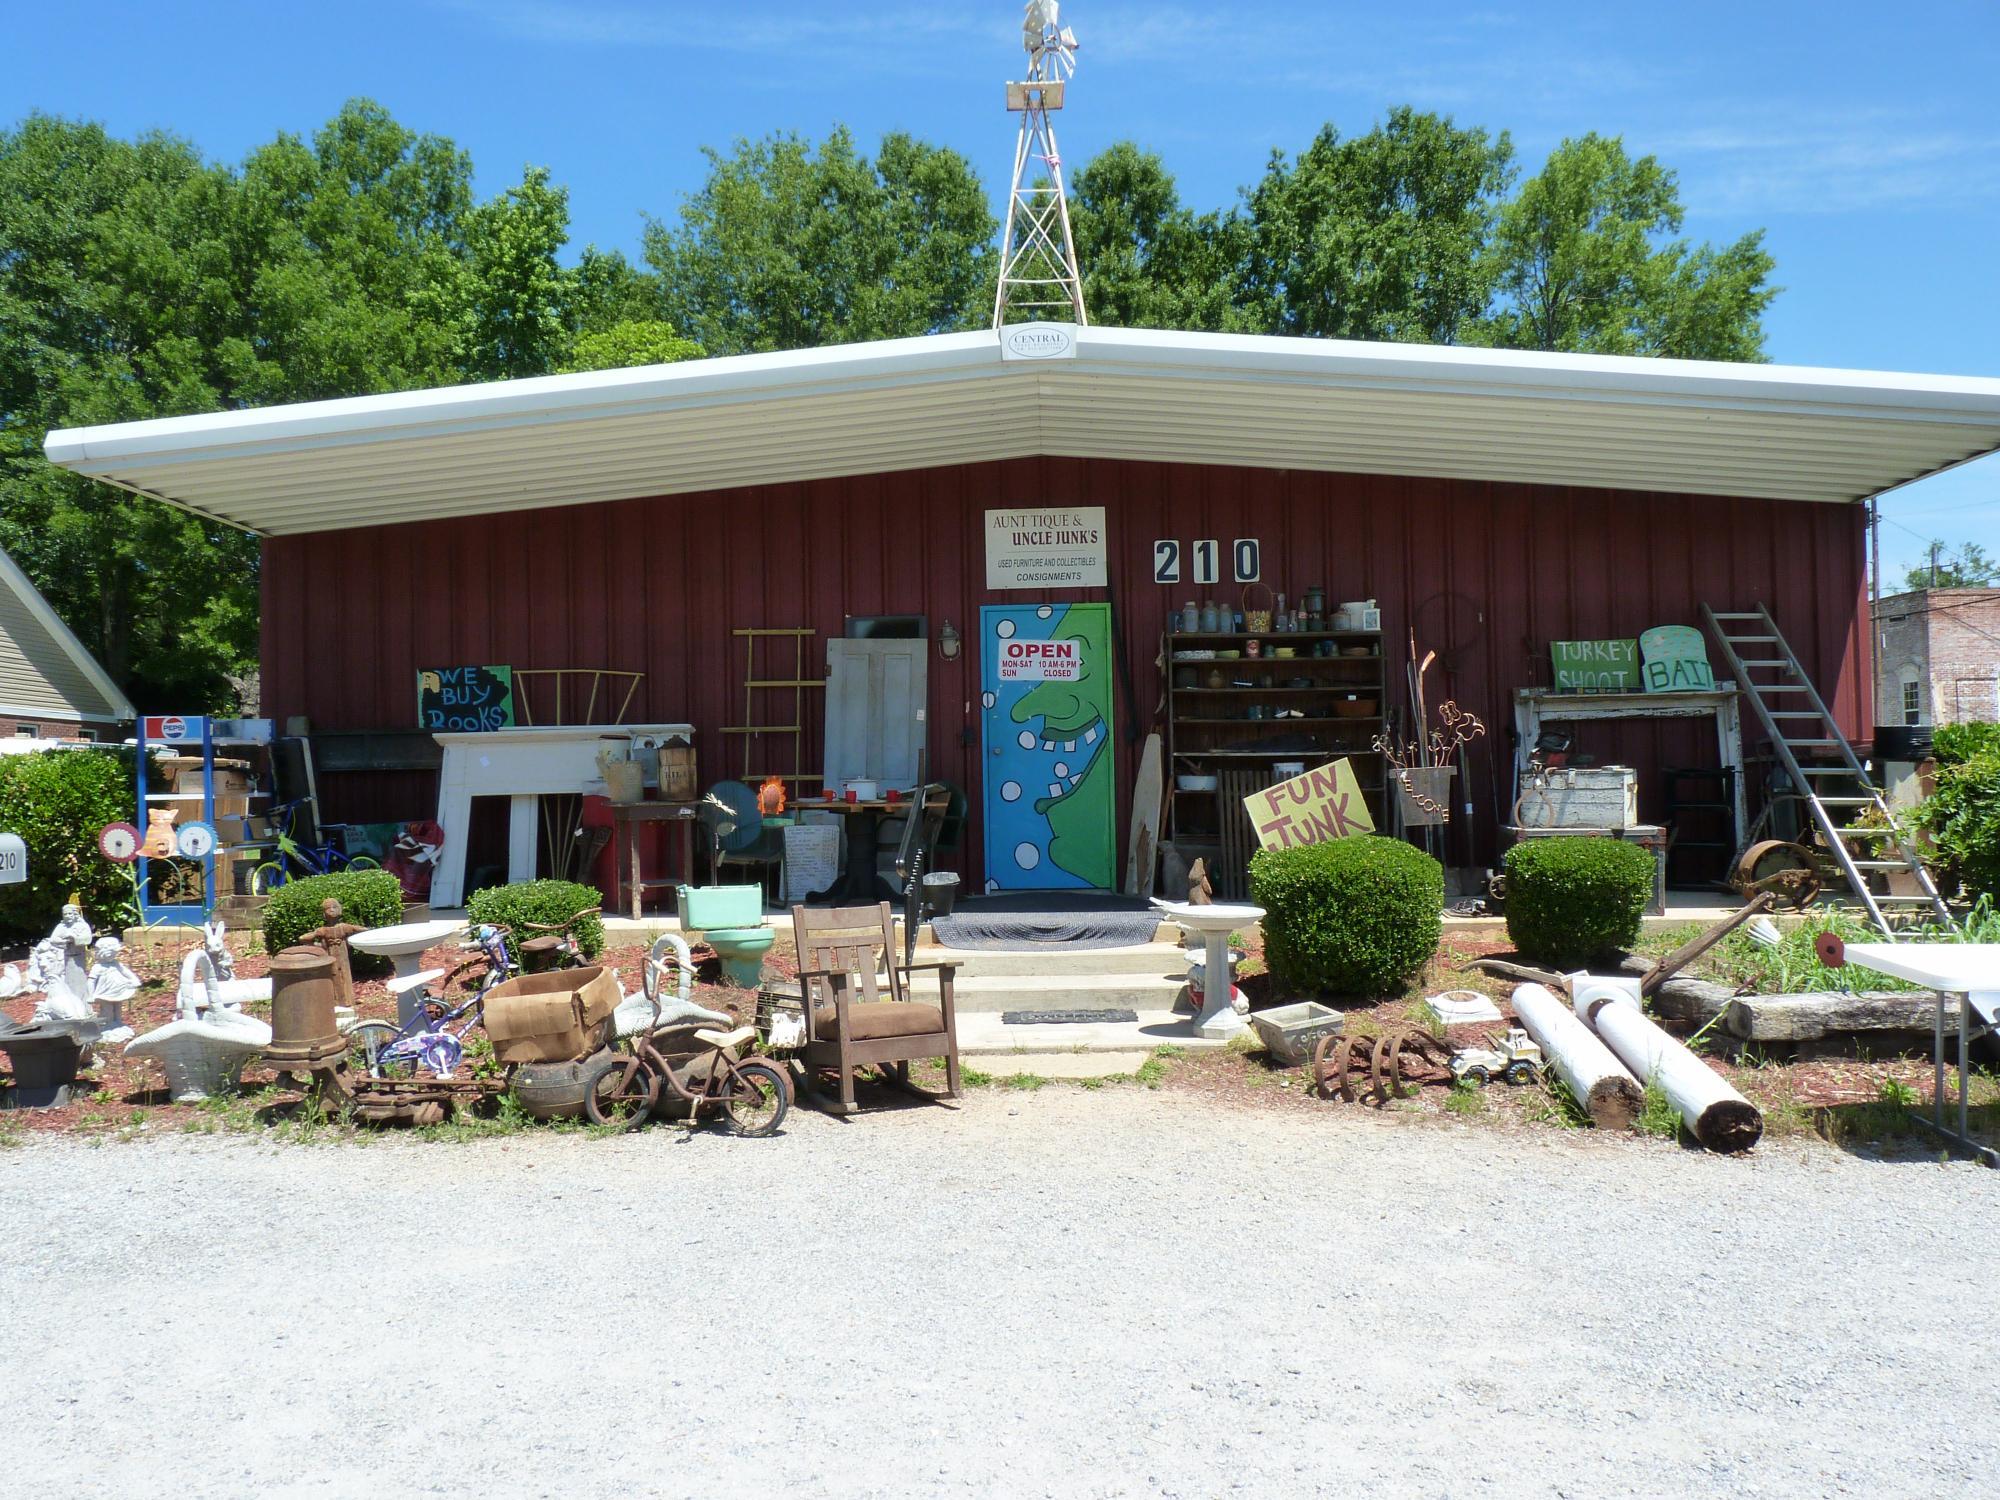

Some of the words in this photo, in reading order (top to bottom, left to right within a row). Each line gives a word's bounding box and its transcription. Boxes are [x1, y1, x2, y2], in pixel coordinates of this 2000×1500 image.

[1014, 334, 1061, 343] CENTRAL
[993, 515, 1027, 528] AUNT
[1030, 514, 1069, 529] TIQUE
[1072, 514, 1083, 527] &
[1012, 531, 1052, 546] UNCLE
[1056, 530, 1098, 545] JUNK'S
[998, 559, 1012, 568] USED
[1013, 558, 1044, 568] FURNITURE
[1044, 558, 1056, 567] AND
[1056, 557, 1096, 567] COLLECTIBLES
[1016, 572, 1082, 582] CONSIGNMENTS
[1007, 644, 1072, 658] OPEN
[1555, 641, 1637, 662] TURKEY
[1039, 660, 1047, 668] 10
[1066, 660, 1077, 668] PM
[433, 667, 478, 685] WE
[1002, 669, 1017, 677] SUN
[1043, 669, 1072, 677] CLOSED
[1559, 670, 1629, 689] SHOOT
[1649, 659, 1713, 689] BAIT
[441, 685, 491, 706] BUY
[163, 724, 186, 732] PEPSI
[1264, 765, 1338, 816] FUN
[1260, 792, 1371, 852] JUNK
